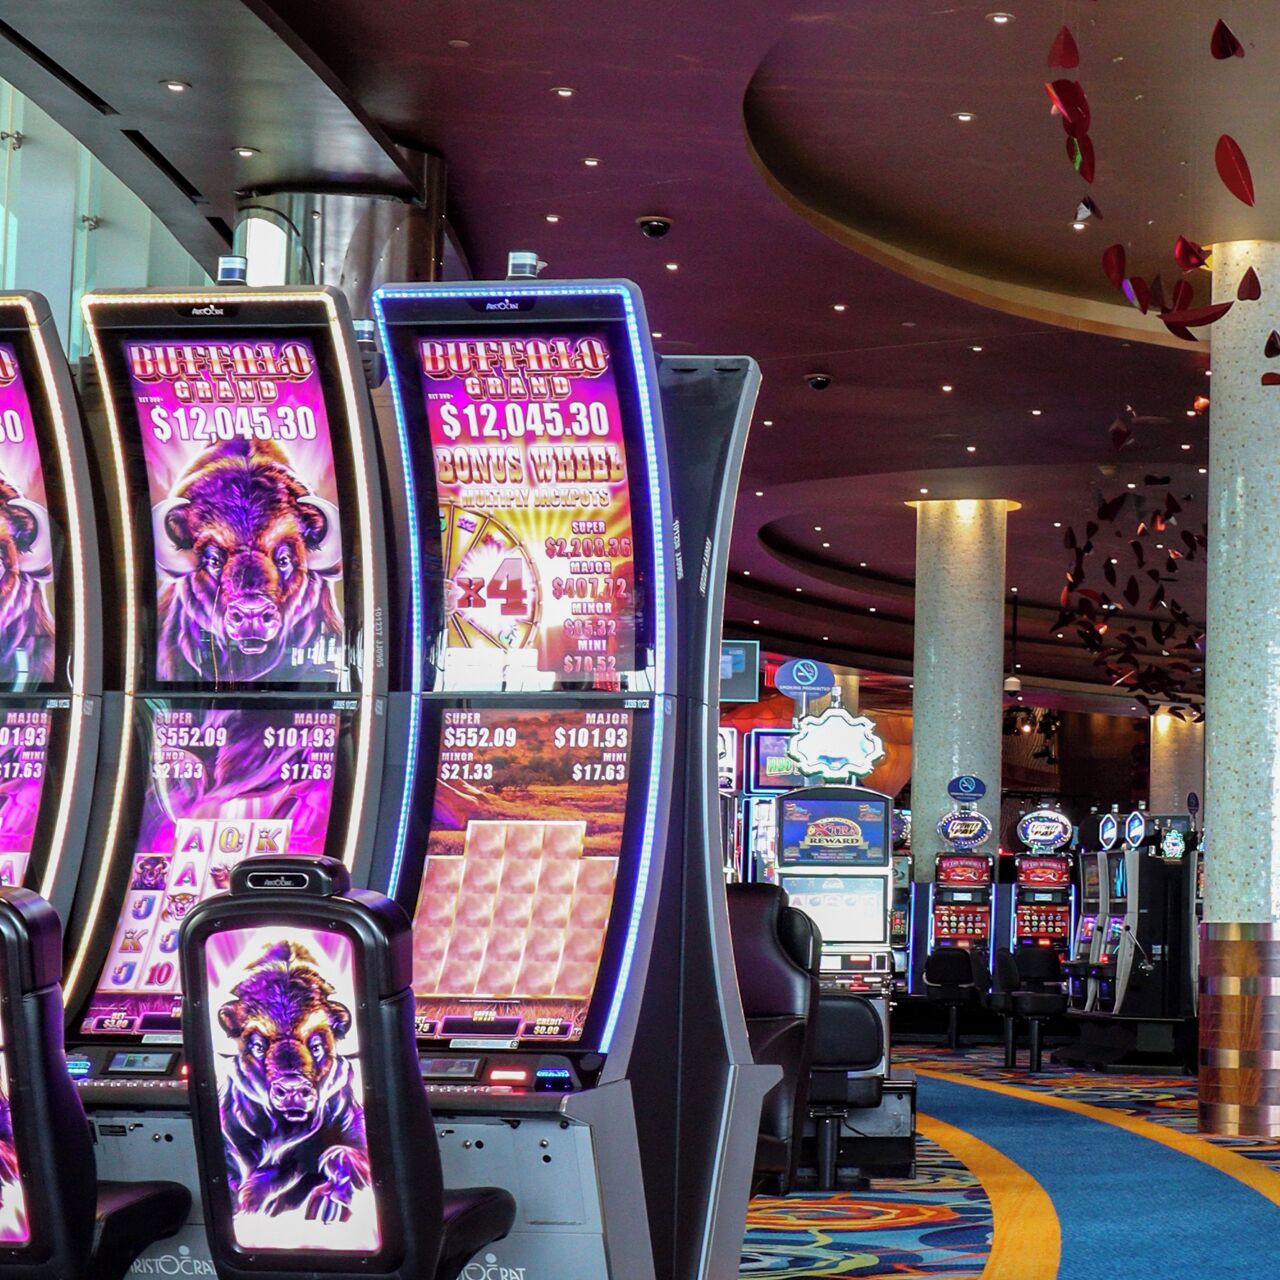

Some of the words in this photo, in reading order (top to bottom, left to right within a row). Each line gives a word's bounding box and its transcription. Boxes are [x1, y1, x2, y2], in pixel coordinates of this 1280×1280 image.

[129, 343, 316, 384] BUFFALO
[420, 339, 609, 380] BUFFALO
[174, 379, 277, 404] GRAND
[464, 375, 571, 401] GRAND
[150, 405, 317, 445] $12,045.30
[439, 401, 610, 440] $12,045.30
[435, 446, 525, 484] BONUS
[530, 445, 626, 484] WHEEL
[461, 488, 529, 508] MULTIPLY
[534, 488, 610, 508] JACKPOTS
[572, 521, 606, 534] SUPER
[545, 536, 632, 559] $2,208.36
[570, 561, 611, 574] MAJOR
[552, 577, 628, 599] $407.72
[571, 602, 613, 615] MINOR
[578, 639, 607, 651] MINI
[7, 712, 48, 725] MAJOR
[156, 713, 192, 724] SUPER
[294, 713, 337, 724] MAJOR
[445, 712, 481, 724] SUPER
[586, 713, 628, 724] MAJOR
[156, 727, 227, 747] $552.09
[263, 727, 336, 747] $101.93
[444, 727, 517, 748] $552.09
[554, 727, 628, 748] $101.93
[22, 751, 45, 760] MINI
[311, 753, 334, 761] MINI
[441, 753, 474, 761] MINOR
[603, 753, 627, 761] MINI
[280, 763, 332, 780] $17.63
[441, 763, 493, 781] $21.33
[572, 763, 625, 781] $17.63
[181, 827, 205, 852] A
[218, 826, 244, 852] Q
[255, 828, 281, 853] K
[174, 861, 197, 886] A
[132, 895, 156, 920] J
[119, 928, 148, 953] K
[111, 961, 137, 985] J
[145, 962, 174, 986] 10
[131, 1249, 216, 1275] RISTOCRA
